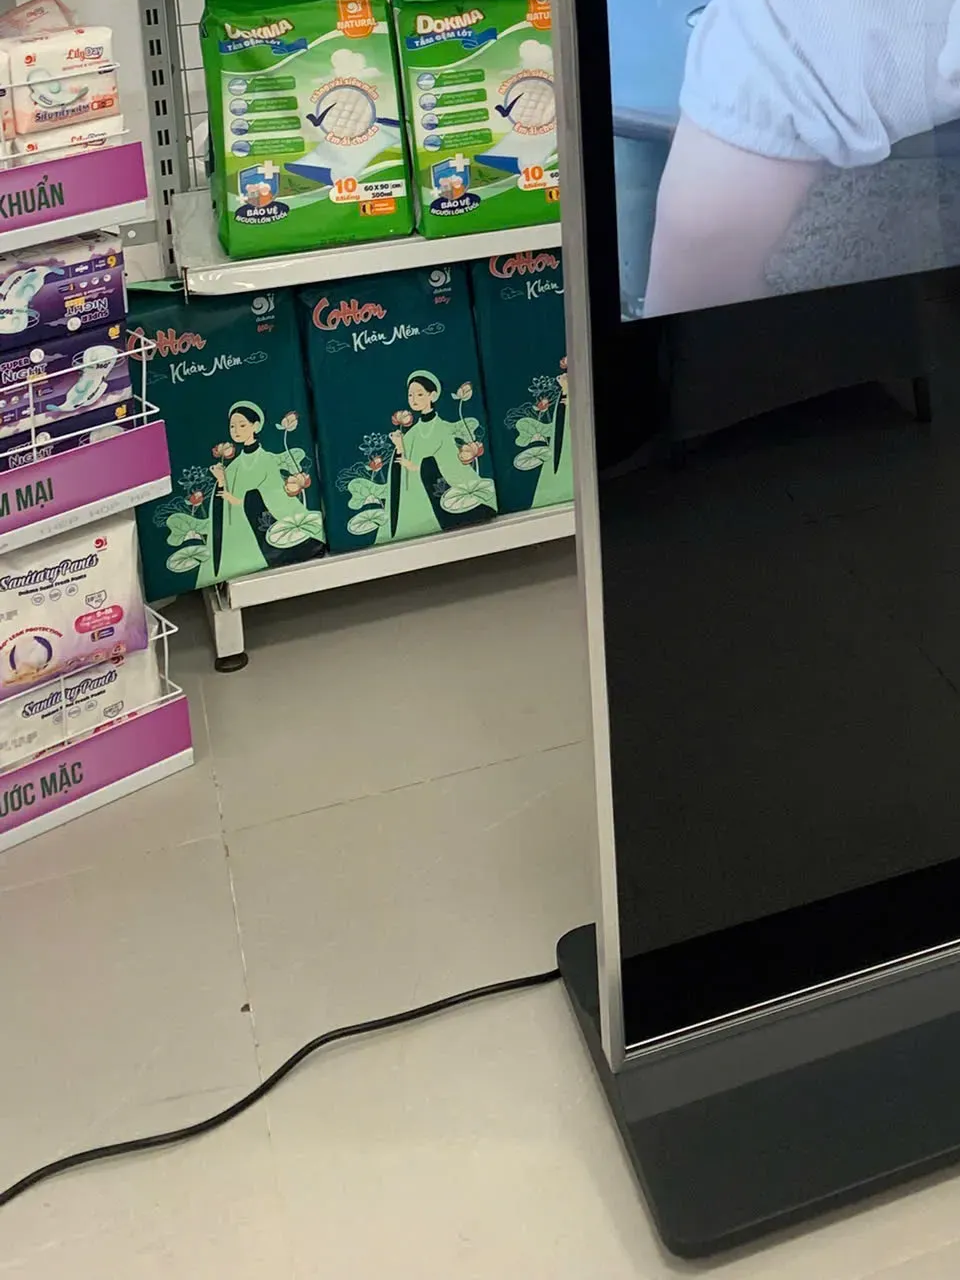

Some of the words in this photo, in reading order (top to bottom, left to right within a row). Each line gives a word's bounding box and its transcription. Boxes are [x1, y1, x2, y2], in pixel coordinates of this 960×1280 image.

[337, 17, 377, 30] NATURAL
[415, 8, 484, 35] DOKMA
[526, 11, 552, 23] NATU
[335, 177, 358, 194] 10
[522, 166, 544, 182] 10
[312, 297, 387, 331] Cotton
[1, 357, 29, 371] SUPER
[15, 477, 54, 509] MẠI
[0, 567, 60, 592] Sanitary
[60, 554, 99, 576] Pants
[79, 670, 117, 694] Pants
[40, 762, 84, 799] MẶC
